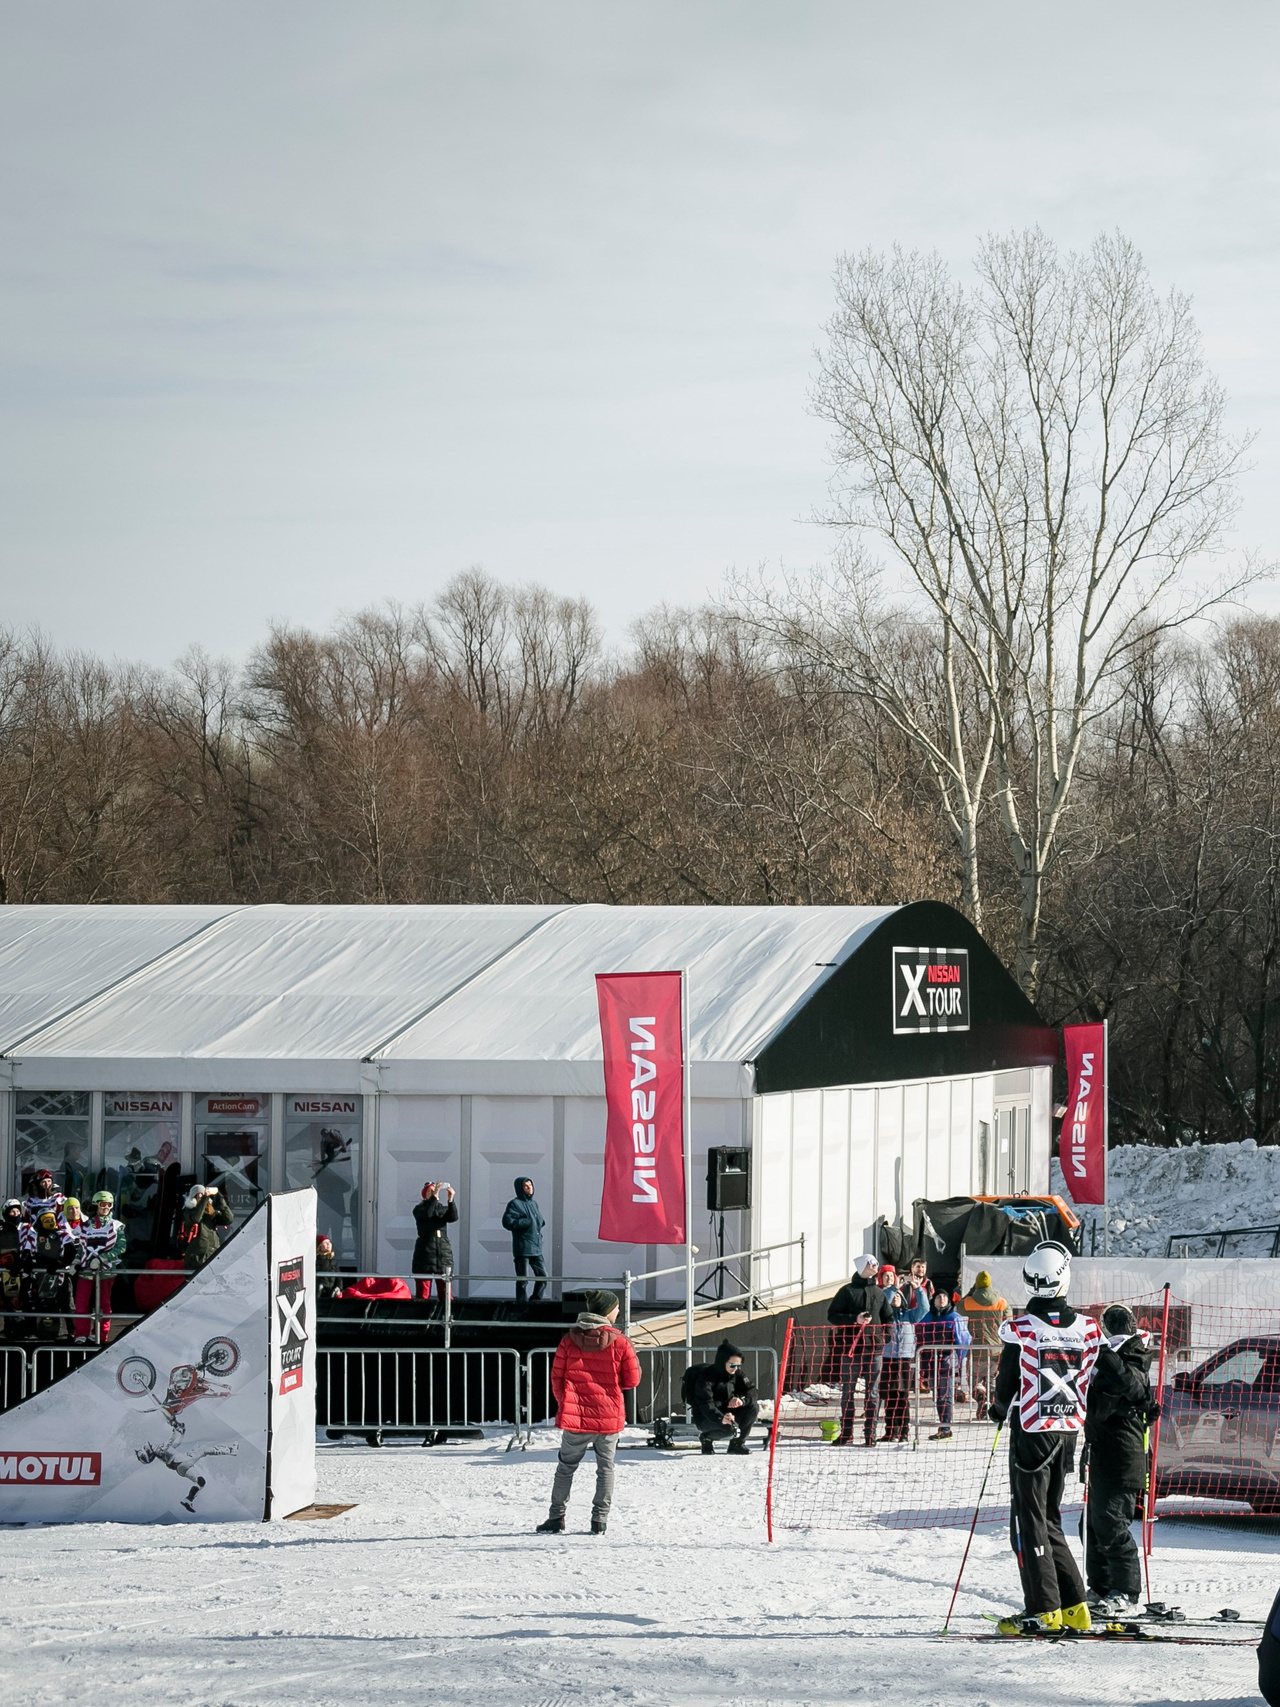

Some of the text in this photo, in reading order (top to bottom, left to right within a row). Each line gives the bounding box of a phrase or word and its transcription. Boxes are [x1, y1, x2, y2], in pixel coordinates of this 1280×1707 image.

[928, 965, 960, 983] NISSAN
[900, 965, 927, 1016] X
[926, 987, 962, 1016] TOUR
[113, 1101, 173, 1112] NISSAN
[294, 1101, 355, 1113] NISSAN
[276, 1288, 308, 1347] X
[282, 1347, 301, 1364] TOUR
[1044, 1353, 1078, 1361] NISSAN
[1037, 1367, 1082, 1402] X
[1043, 1403, 1075, 1414] TOUR
[0, 1456, 96, 1480] MOTUL
